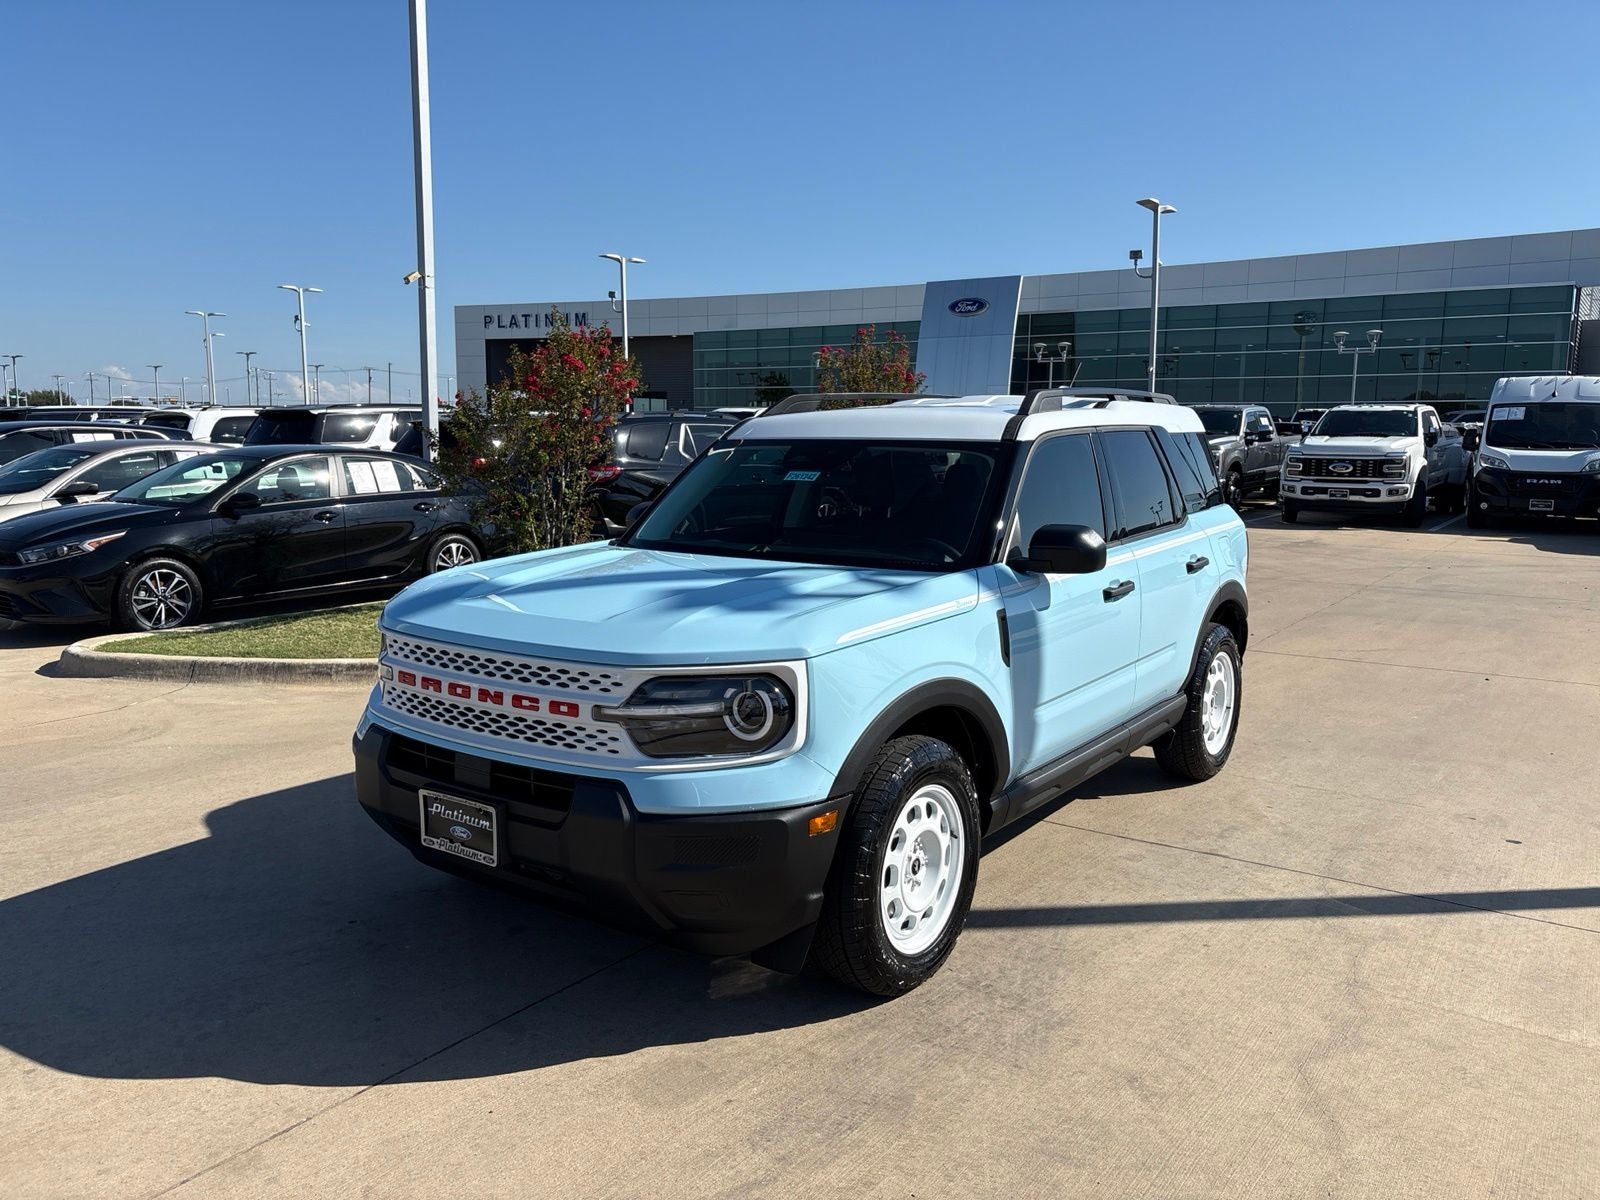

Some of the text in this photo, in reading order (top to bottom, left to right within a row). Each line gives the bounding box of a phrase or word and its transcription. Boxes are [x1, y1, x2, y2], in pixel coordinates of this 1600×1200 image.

[955, 301, 979, 312] Ford
[398, 670, 579, 718] BRONCO
[428, 803, 493, 832] Platinum
[438, 839, 479, 860] Platinum
